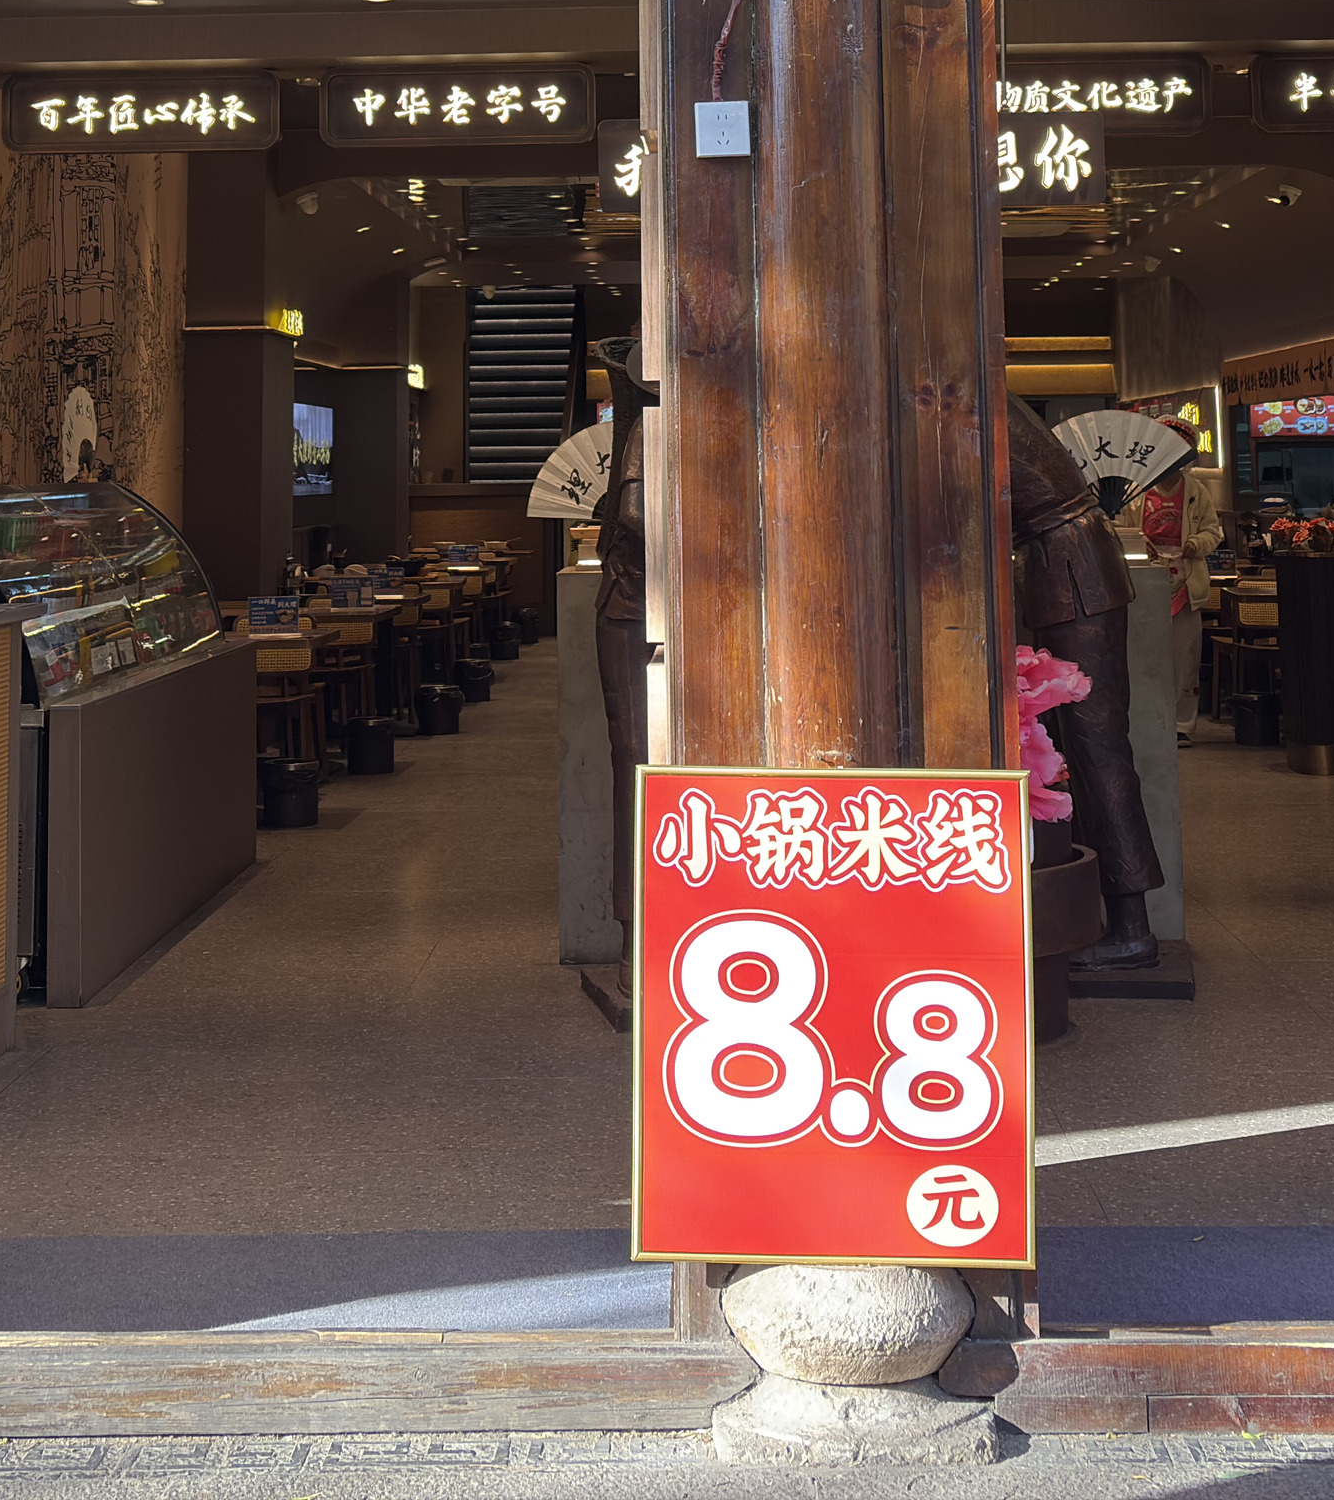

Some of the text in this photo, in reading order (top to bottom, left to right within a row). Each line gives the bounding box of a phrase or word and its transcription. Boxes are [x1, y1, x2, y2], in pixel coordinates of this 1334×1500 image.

[31, 92, 256, 134] 百年匠心传承
[353, 84, 567, 126] 中华老字号
[996, 77, 1192, 114] 物质文化遗产
